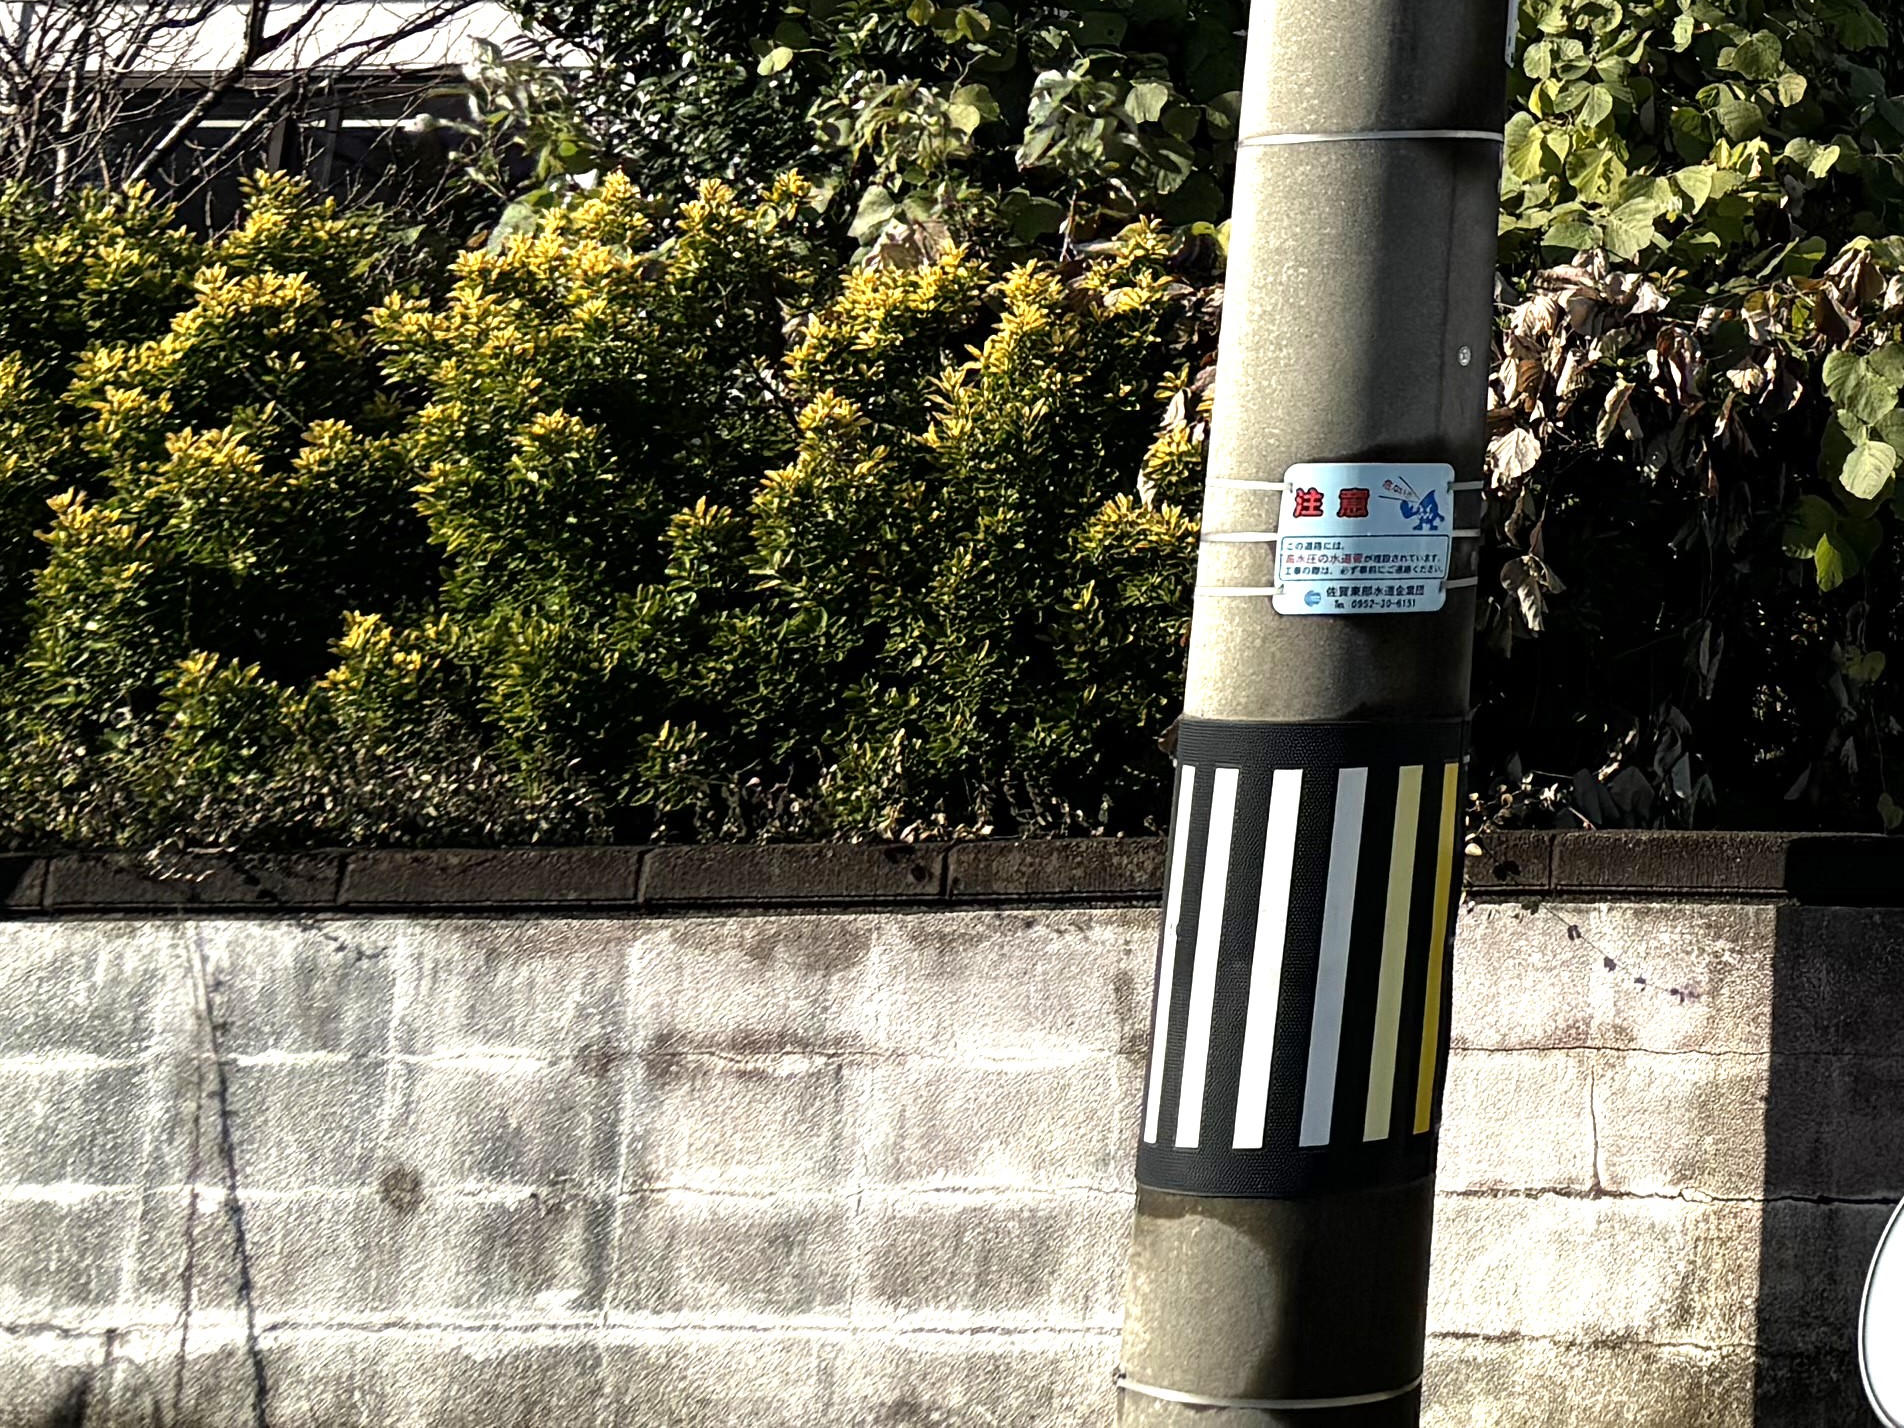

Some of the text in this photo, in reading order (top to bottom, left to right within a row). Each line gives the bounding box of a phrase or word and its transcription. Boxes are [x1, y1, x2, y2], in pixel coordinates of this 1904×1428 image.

[1293, 487, 1370, 518] 注意
[1326, 585, 1425, 597] 佐賀東部水道企業団
